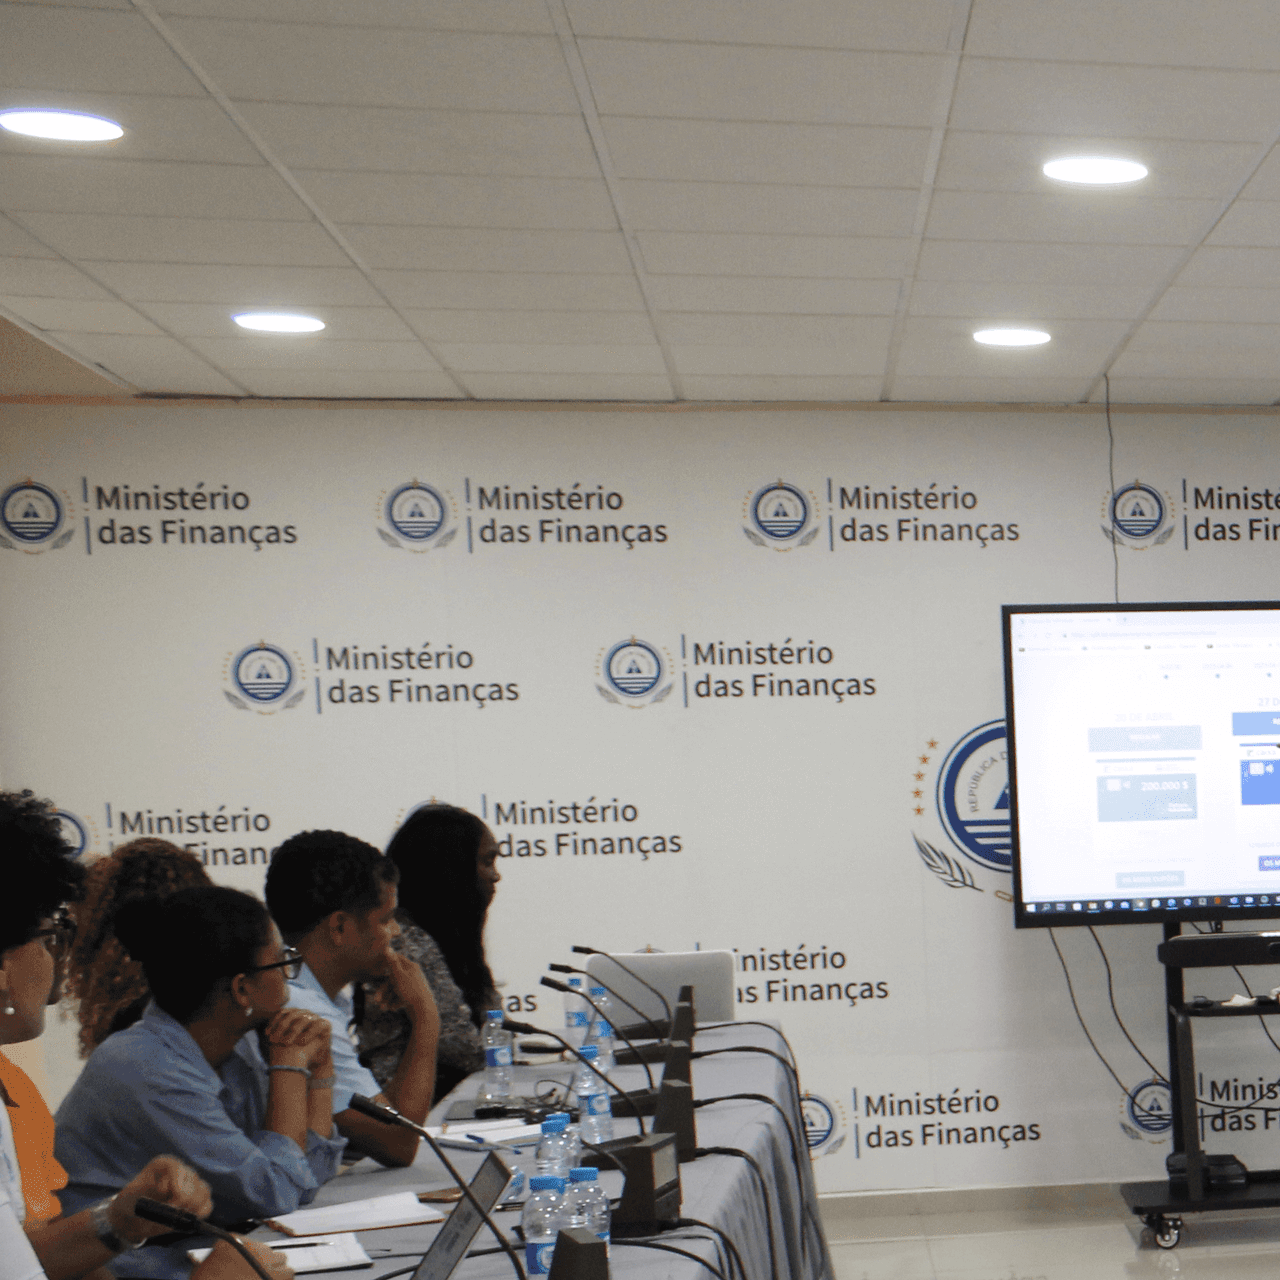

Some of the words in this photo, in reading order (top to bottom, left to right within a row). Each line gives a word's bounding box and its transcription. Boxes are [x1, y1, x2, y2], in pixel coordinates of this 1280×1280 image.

[95, 482, 249, 510] Ministério
[478, 483, 623, 510] Ministério
[840, 483, 977, 510] Ministério
[98, 519, 152, 544] das
[161, 518, 297, 550] Finanças
[479, 518, 530, 543] das
[539, 518, 667, 549] Finanças
[840, 518, 889, 542] das
[897, 517, 1019, 547] Finanças
[1194, 517, 1240, 541] das
[326, 642, 473, 670] Ministério
[694, 638, 833, 665] Ministério
[328, 679, 380, 704] das
[389, 678, 519, 708] Finanças
[695, 674, 743, 698] das
[752, 673, 876, 702] Finanças
[968, 756, 999, 813] REPÚBLICA
[120, 805, 271, 834] Ministério
[495, 796, 637, 825] Ministério
[185, 842, 273, 866] inan
[498, 833, 547, 857] das
[554, 832, 682, 861] Finanças
[766, 976, 889, 1006] Finanças
[865, 1088, 999, 1117] Ministério
[1211, 1109, 1256, 1132] das
[866, 1125, 913, 1148] das
[922, 1122, 1041, 1149] Finanças
